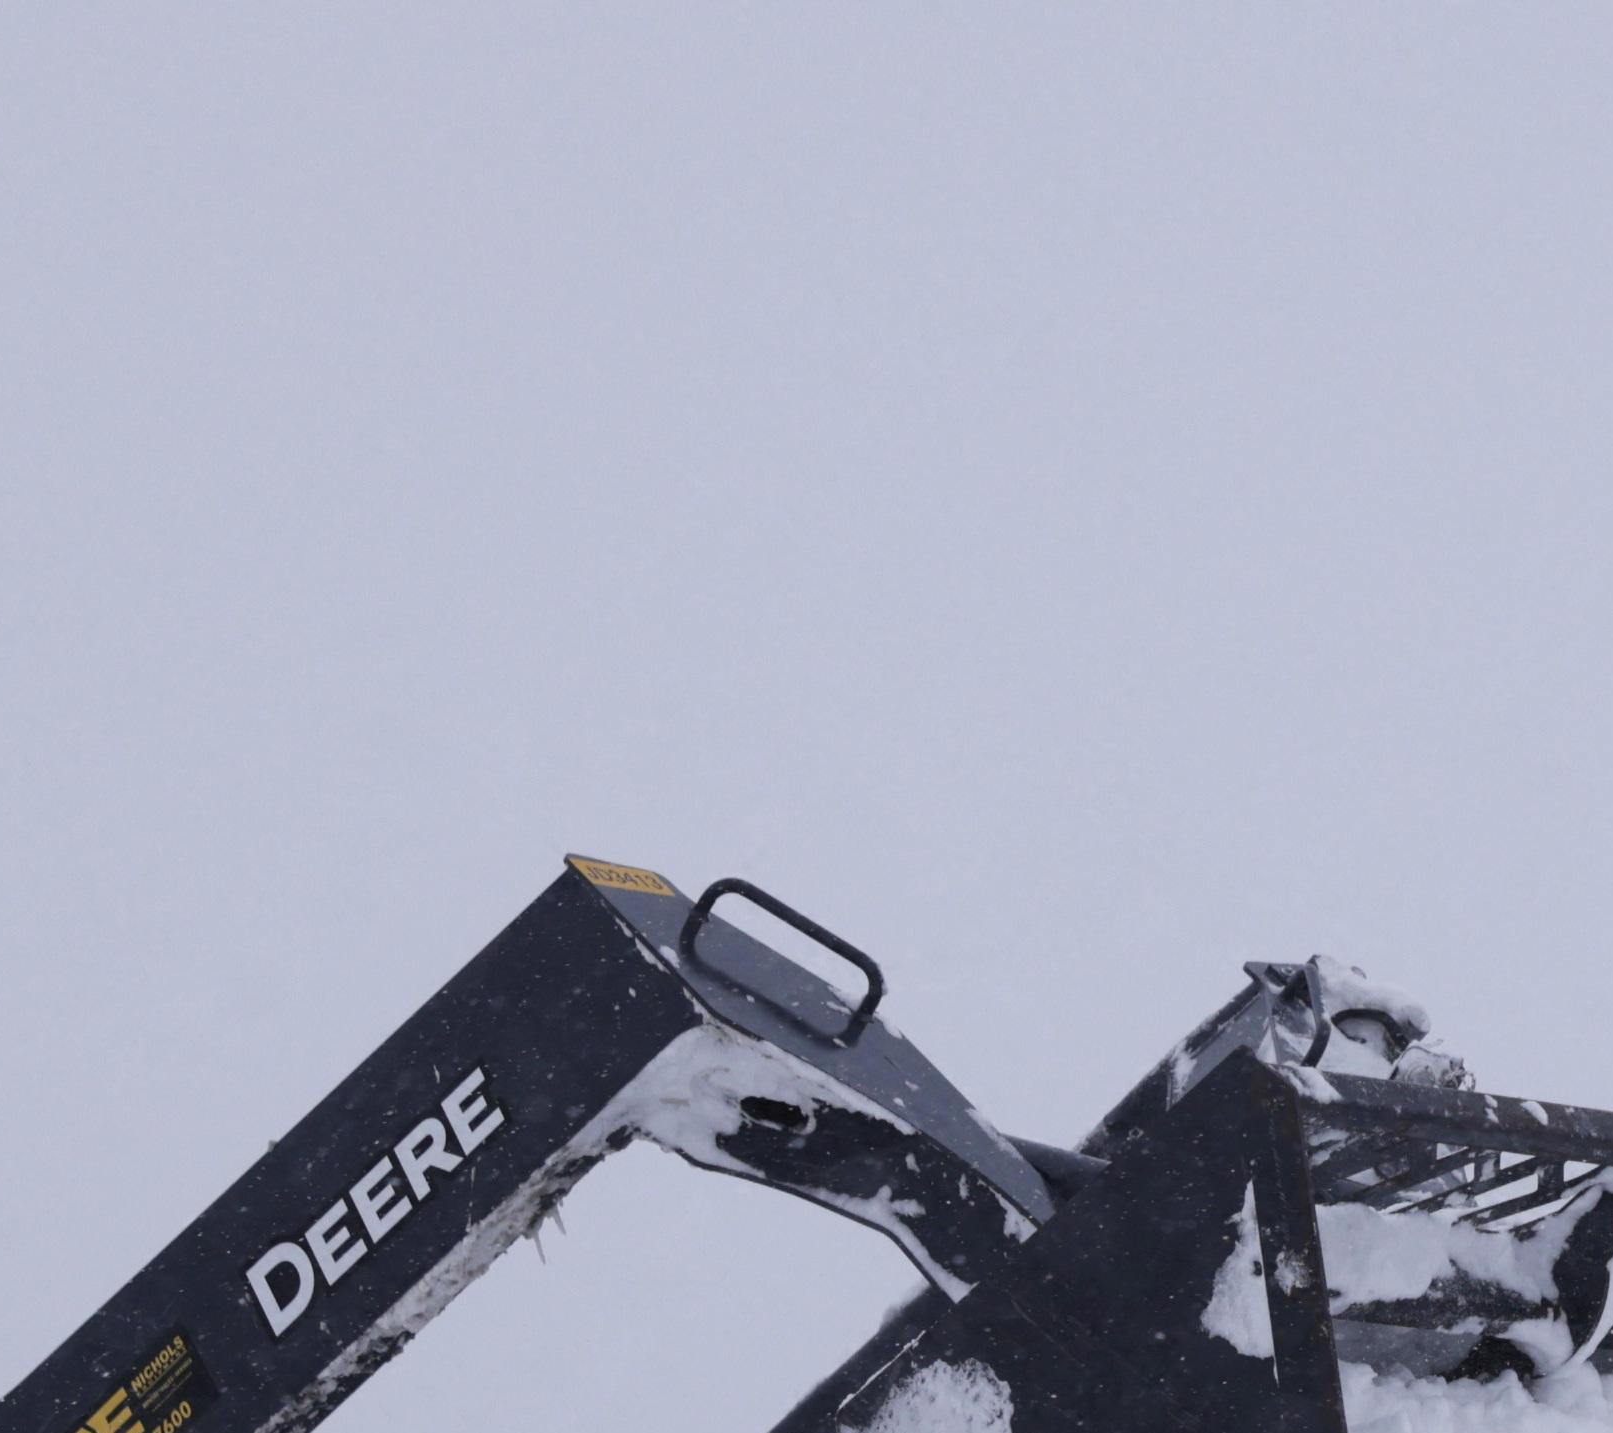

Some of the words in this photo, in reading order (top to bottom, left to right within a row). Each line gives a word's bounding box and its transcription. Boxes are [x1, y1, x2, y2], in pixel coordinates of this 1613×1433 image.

[586, 865, 664, 891] JD3413
[245, 1065, 506, 1338] DEERE
[130, 1335, 184, 1392] NICHOLS
